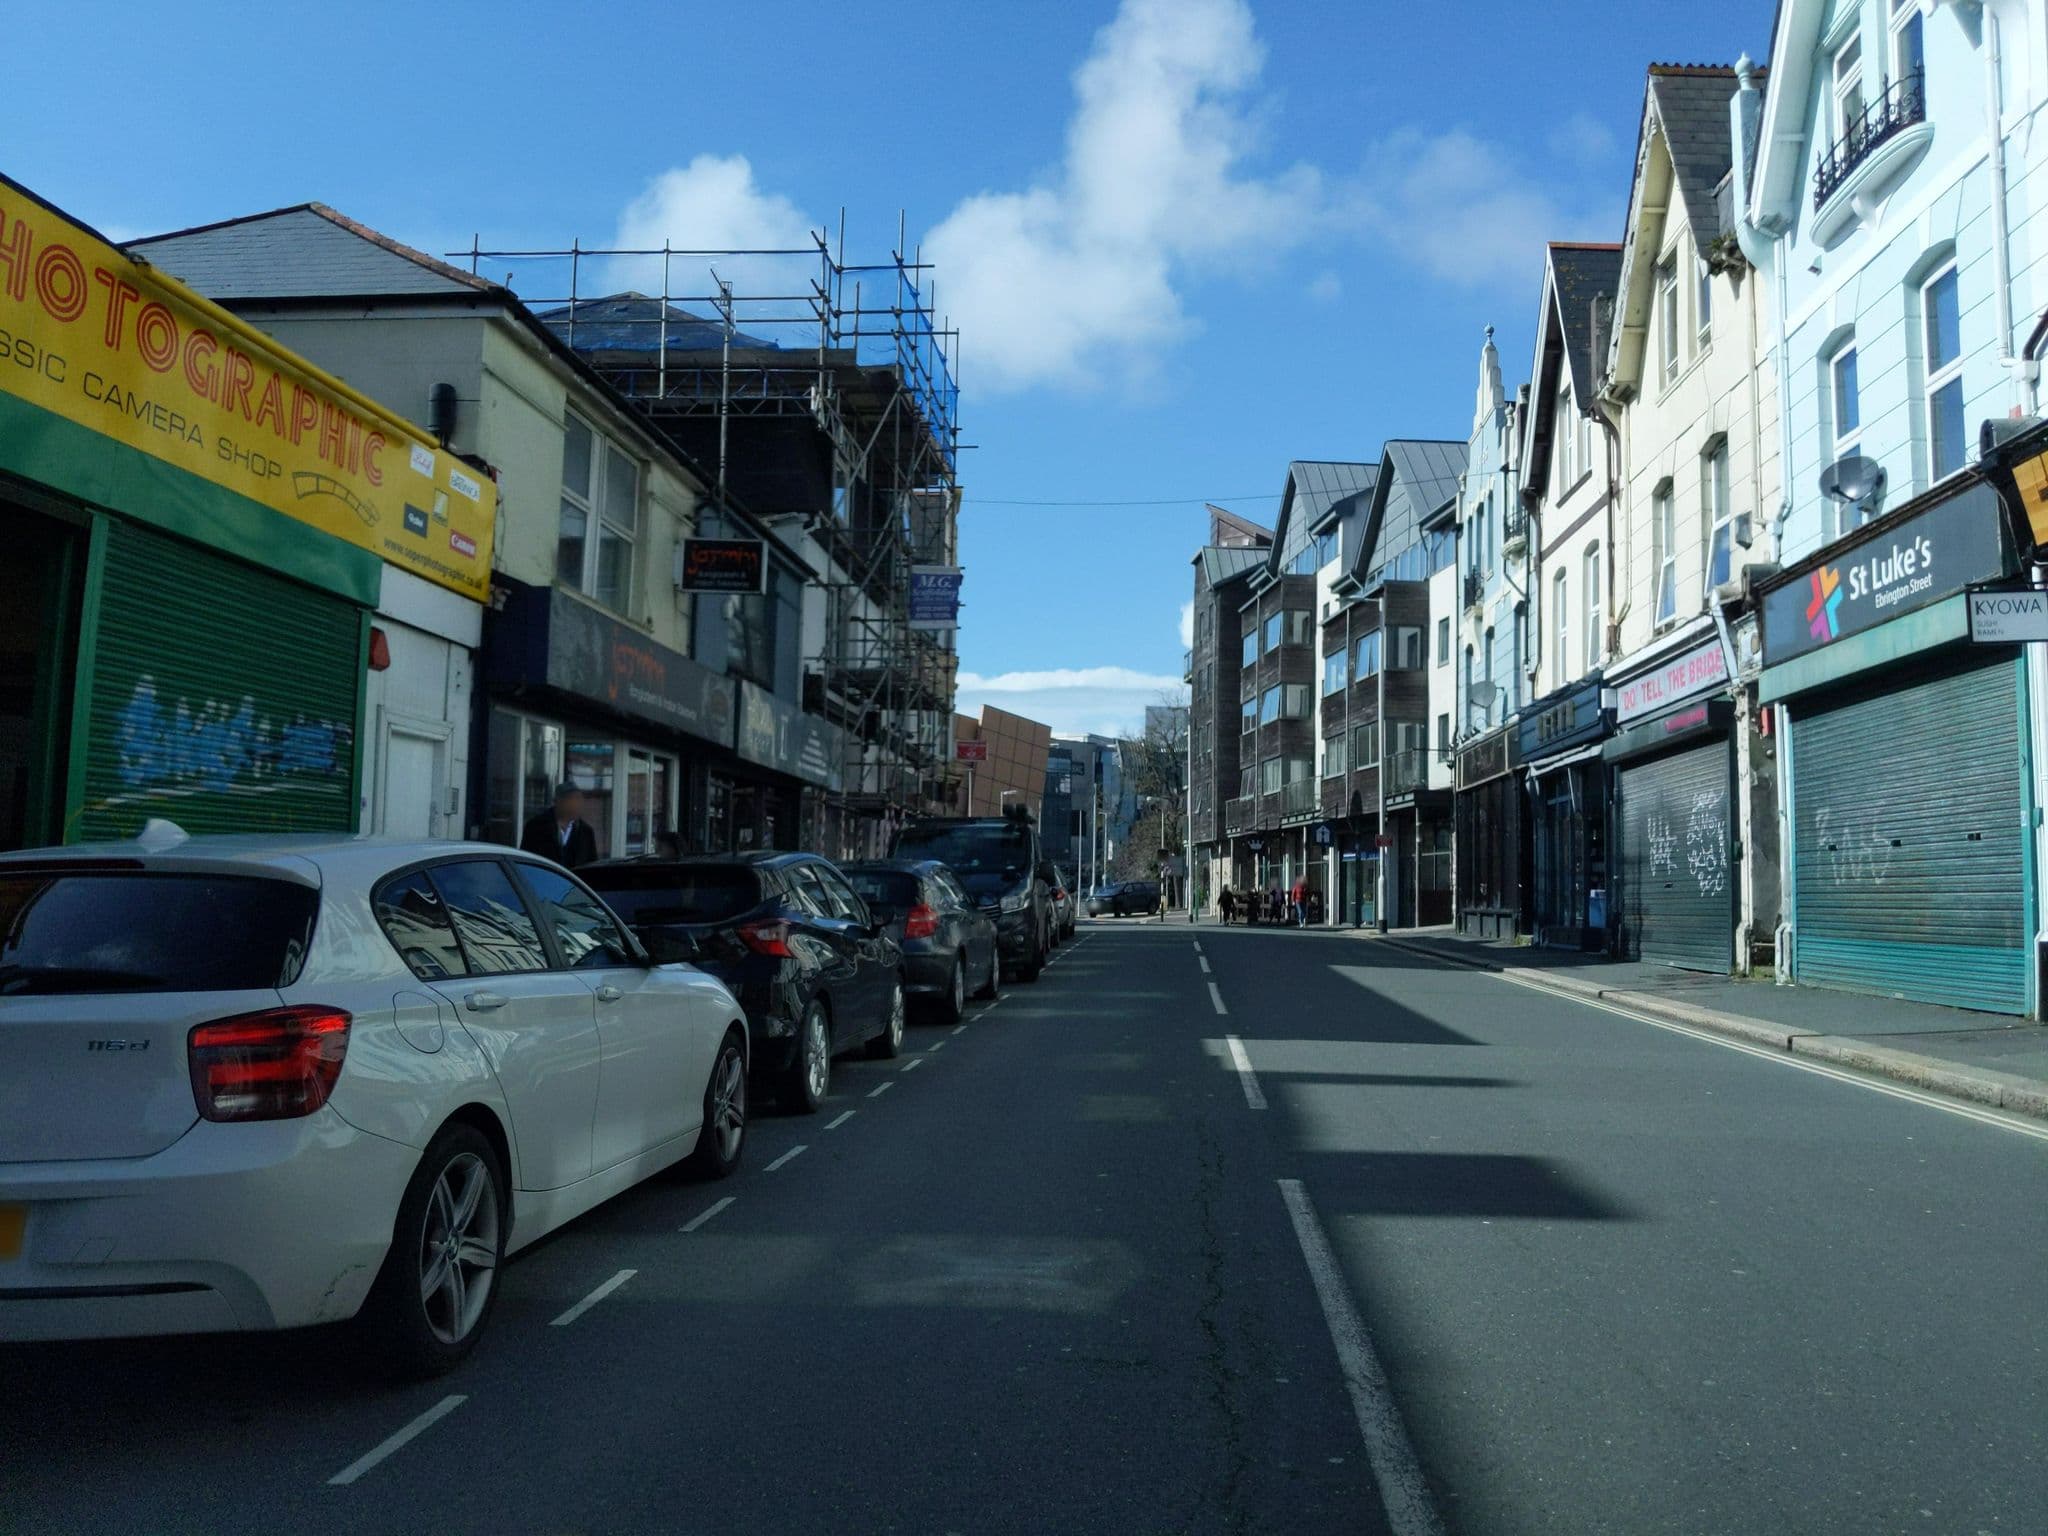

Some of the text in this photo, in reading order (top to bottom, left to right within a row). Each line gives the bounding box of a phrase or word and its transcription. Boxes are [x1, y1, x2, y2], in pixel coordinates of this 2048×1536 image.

[83, 372, 204, 449] CAMERA
[217, 437, 282, 480] SHOP
[1849, 536, 1931, 600] St Luke's
[1875, 572, 1932, 609] Ebrington Street
[1975, 598, 2042, 616] KYOWA
[1641, 674, 1664, 704] TELL
[1667, 664, 1686, 692] THE
[1688, 646, 1723, 683] BRIDE
